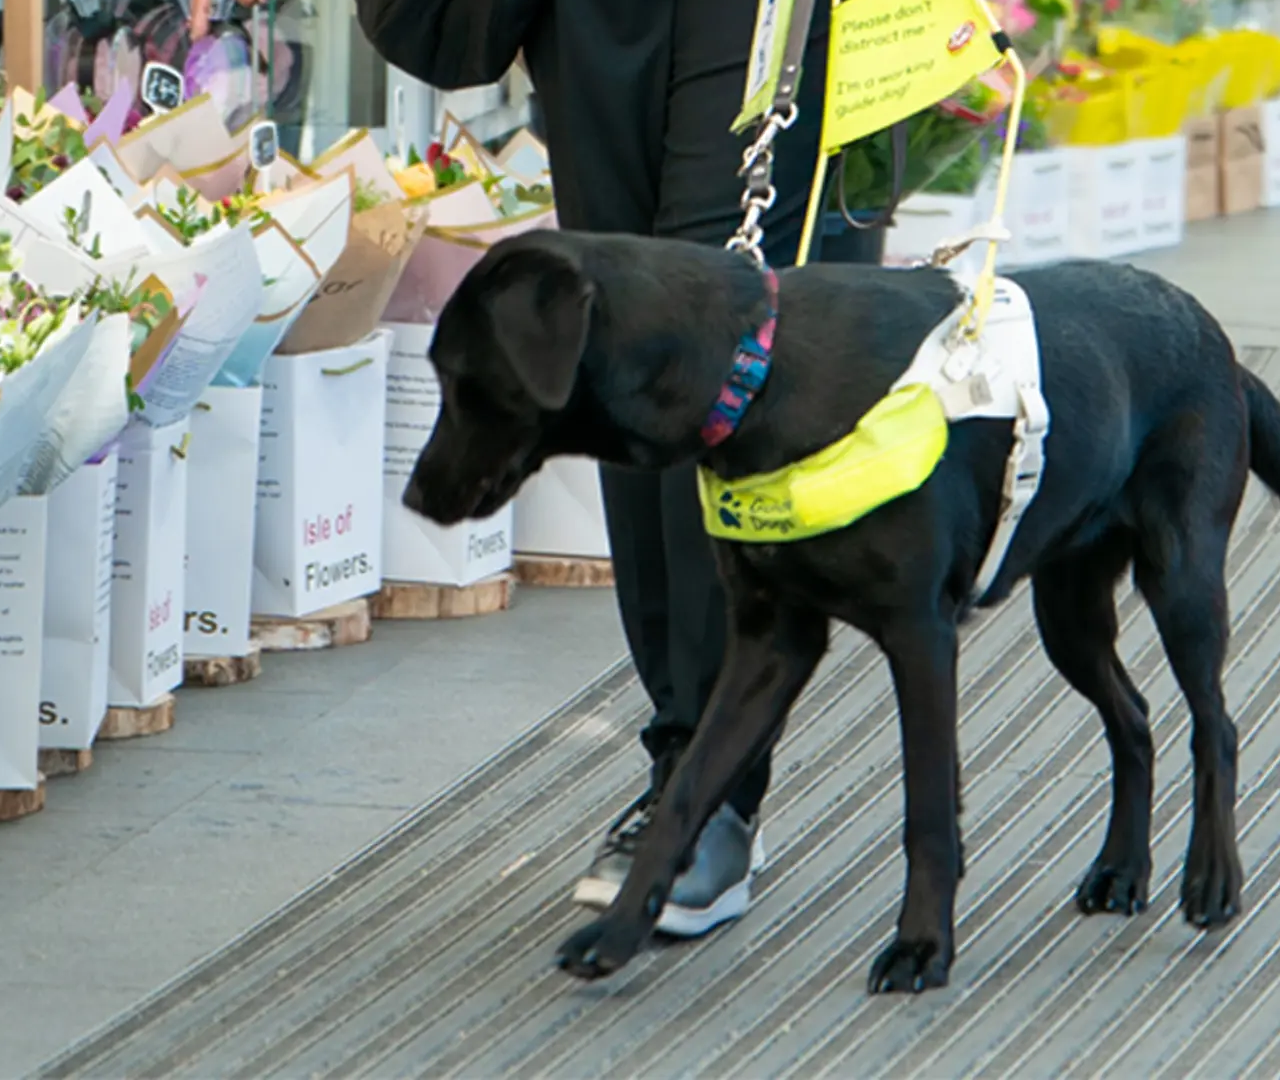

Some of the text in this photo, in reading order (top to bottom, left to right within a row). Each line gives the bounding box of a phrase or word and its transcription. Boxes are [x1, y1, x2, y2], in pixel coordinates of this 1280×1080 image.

[841, 0, 932, 35] Please don't
[839, 30, 899, 55] distract
[902, 25, 925, 39] me
[836, 59, 935, 95] I'm a working
[835, 94, 876, 121] guide
[304, 504, 353, 546] Isle of
[306, 552, 373, 593] Flowers.
